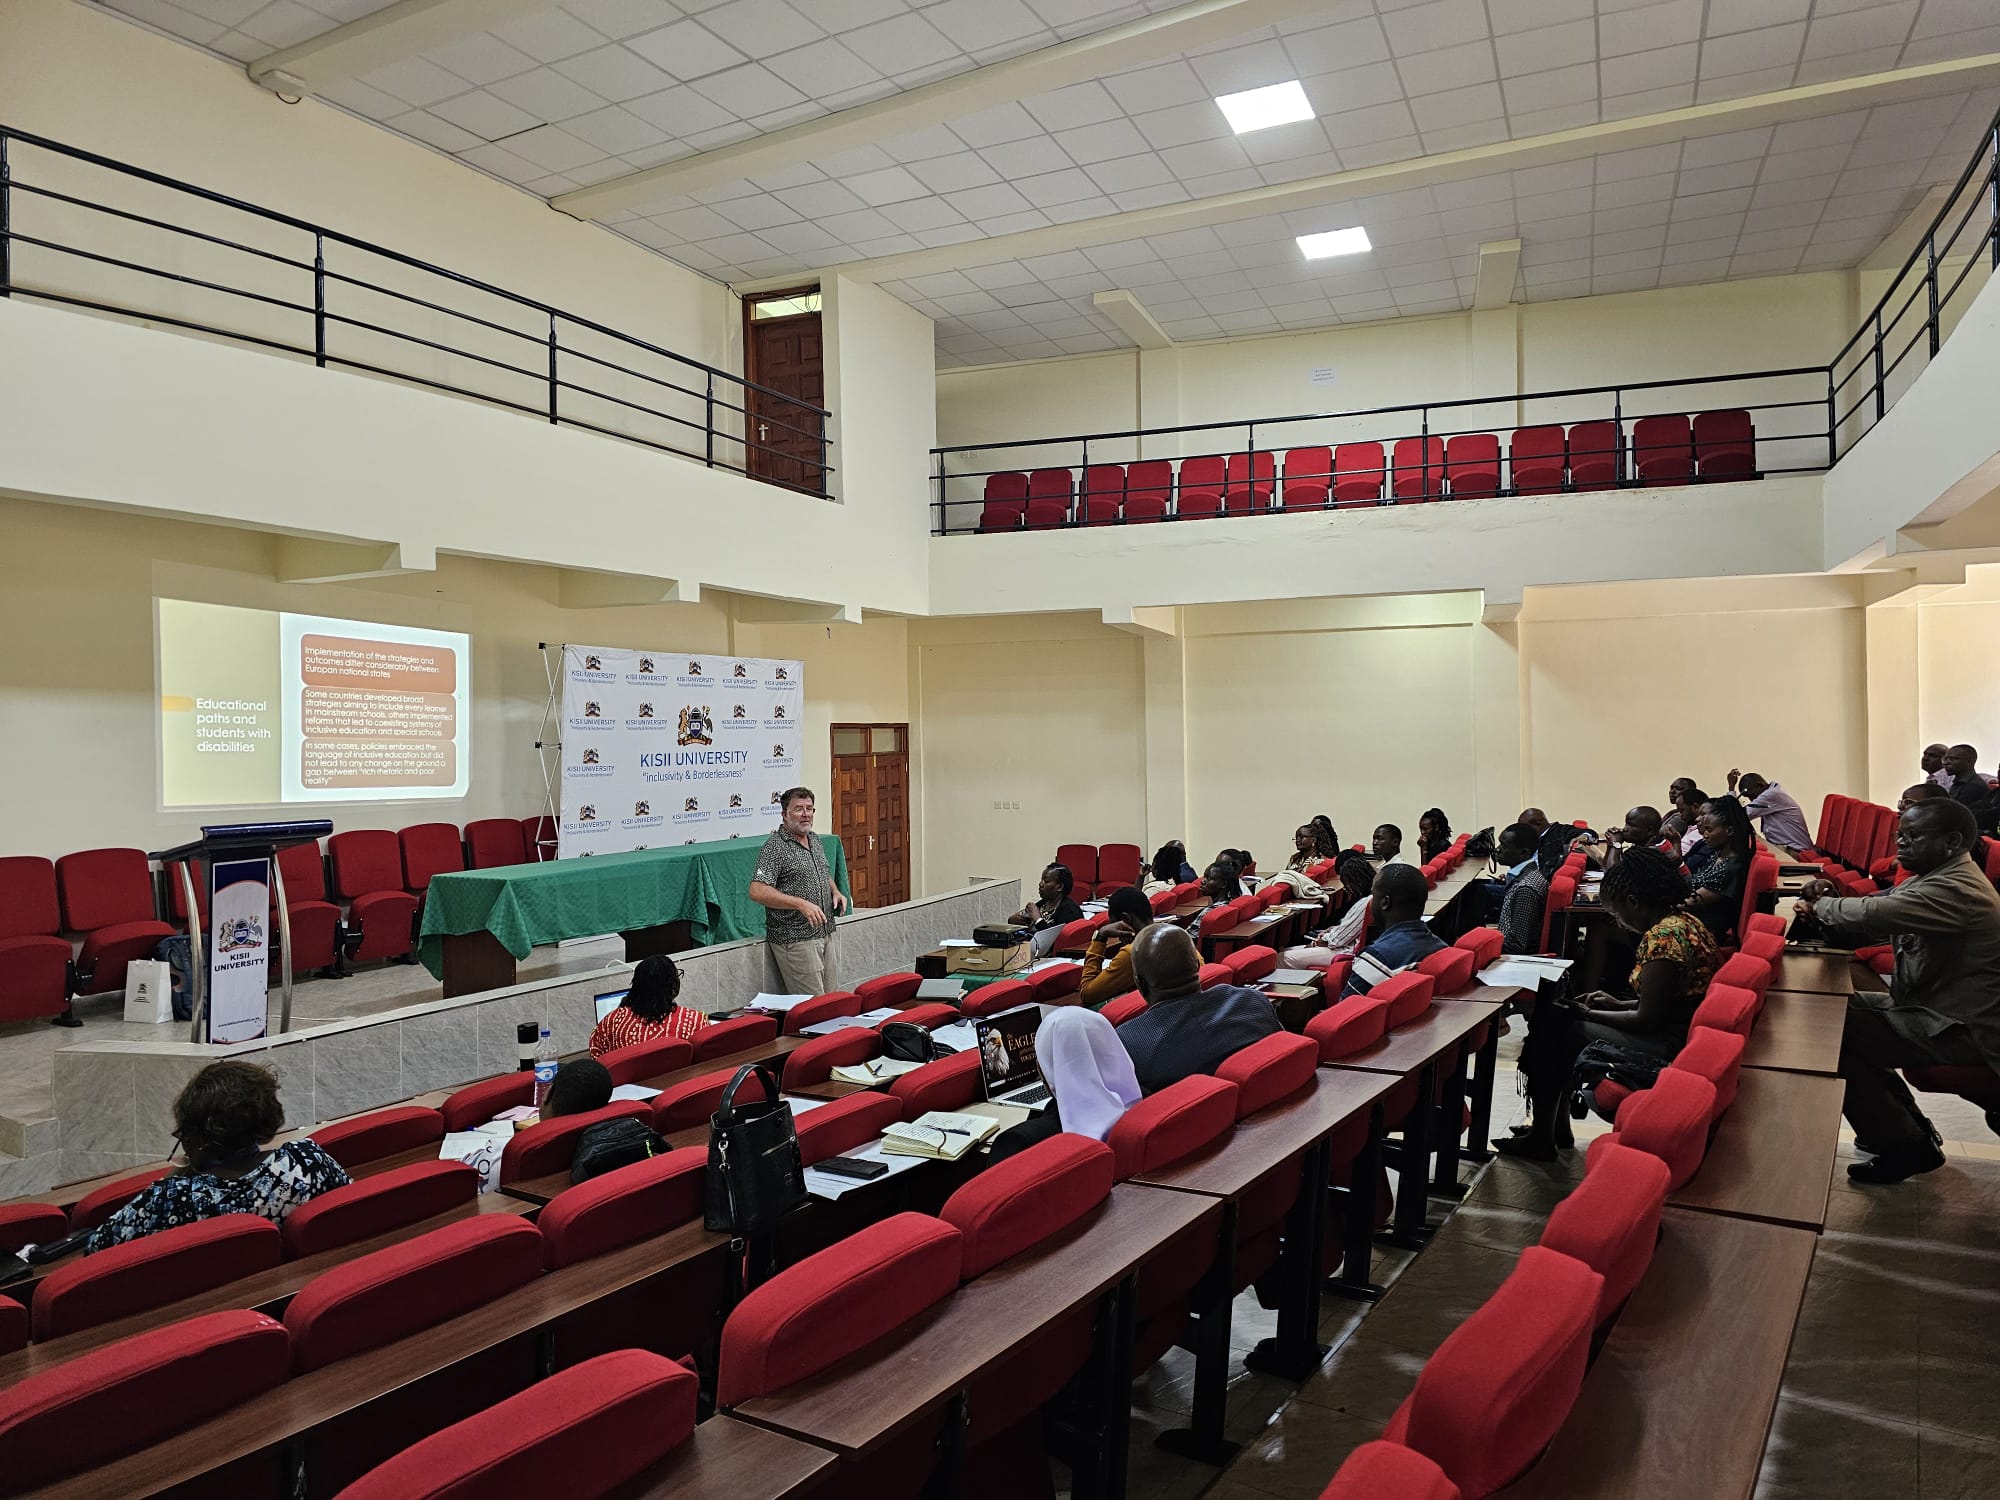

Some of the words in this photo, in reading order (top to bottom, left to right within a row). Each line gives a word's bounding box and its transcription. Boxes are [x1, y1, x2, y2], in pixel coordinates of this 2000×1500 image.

[304, 646, 365, 658] Implementation
[375, 652, 386, 660] the
[388, 654, 419, 664] strategies
[305, 657, 344, 666] outcomes
[345, 659, 364, 667] differ
[365, 661, 409, 672] considerably
[410, 664, 440, 672] between
[339, 668, 368, 676] national
[370, 670, 390, 678] states
[305, 690, 328, 698] Some
[329, 692, 362, 700] countries
[364, 693, 402, 702] developed
[196, 698, 267, 712] Educational
[305, 699, 342, 708] strategies
[343, 701, 368, 710] aiming
[378, 702, 404, 710] include
[196, 713, 230, 725] paths
[232, 714, 256, 724] and
[314, 709, 358, 717] mainstream
[410, 712, 452, 720] implemented
[305, 716, 334, 725] reforms
[196, 727, 246, 738] students
[248, 728, 271, 738] with
[305, 726, 338, 734] inclusive
[196, 740, 255, 752] disabilities
[361, 742, 388, 751] policies
[305, 750, 343, 760] language
[640, 752, 671, 768] KISII
[676, 750, 748, 766] UNIVERSITY
[364, 760, 392, 768] change
[416, 759, 440, 768] ground
[685, 770, 691, 780] &
[230, 952, 250, 961] KISII
[214, 958, 264, 972] UNIVERSITY
